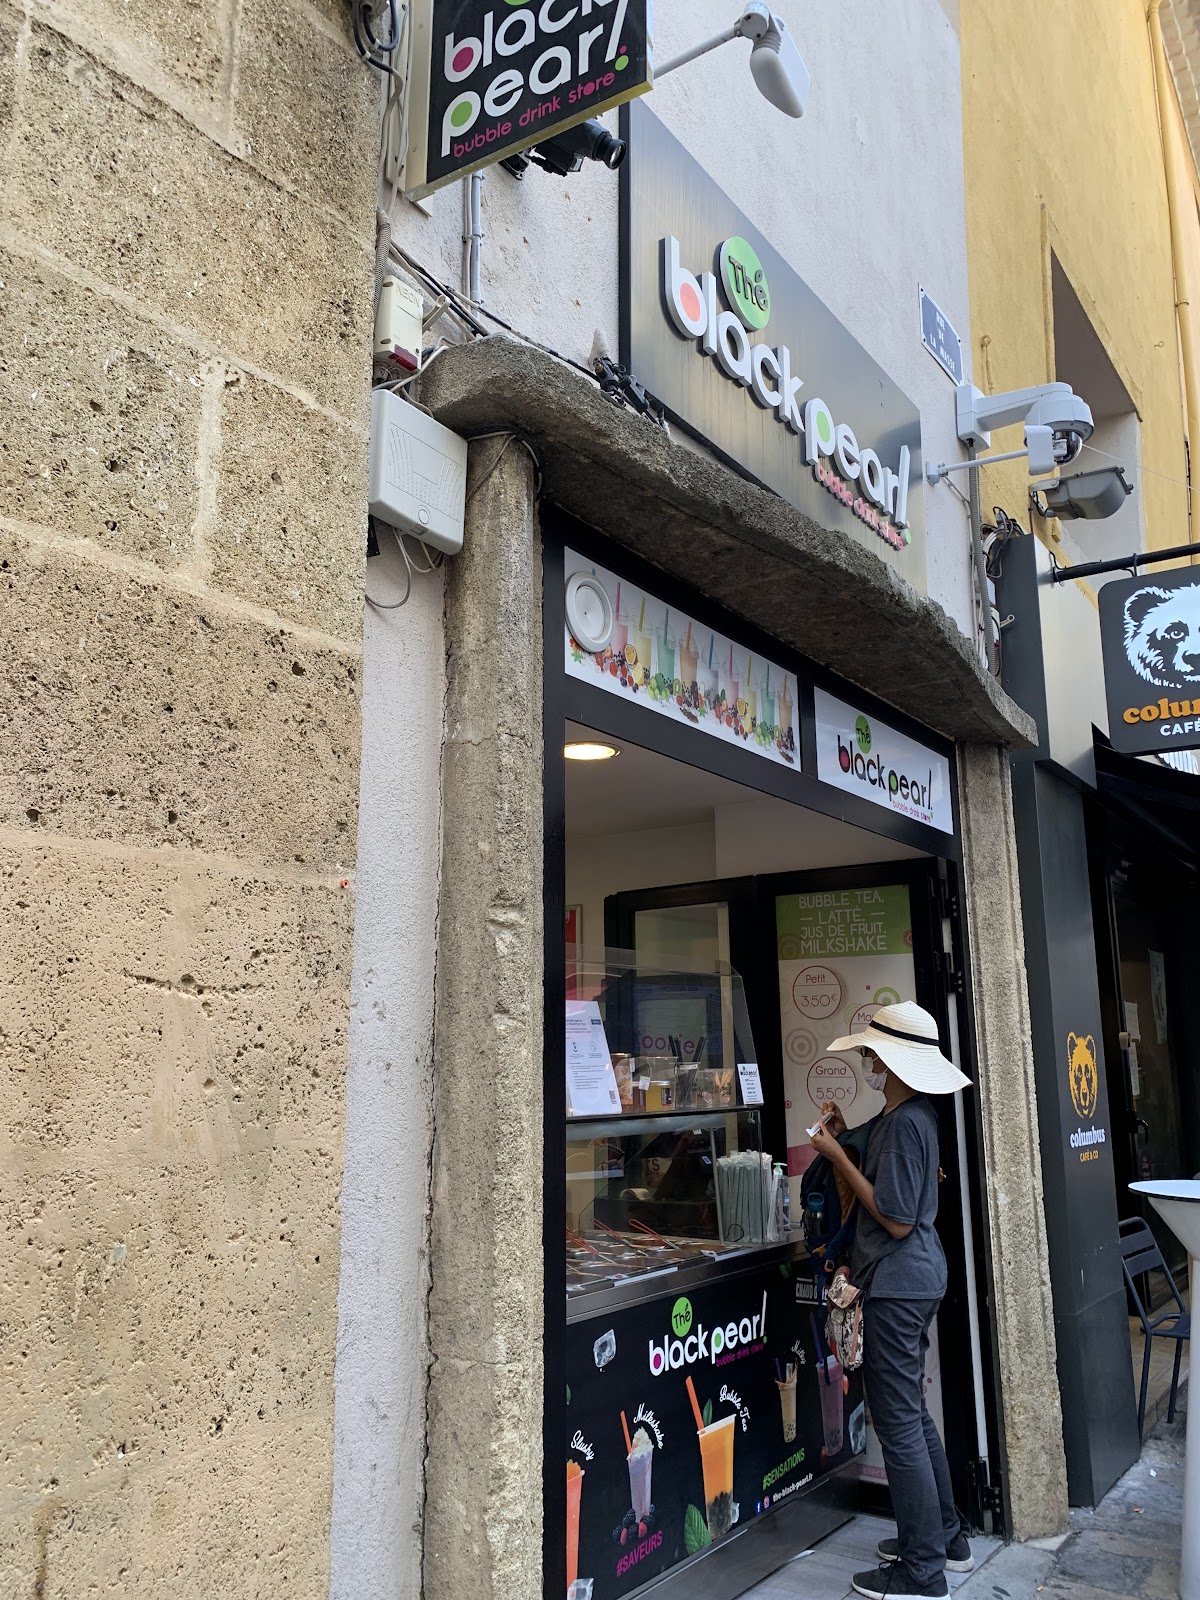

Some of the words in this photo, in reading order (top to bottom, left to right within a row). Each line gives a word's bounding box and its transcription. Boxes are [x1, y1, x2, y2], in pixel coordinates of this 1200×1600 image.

[444, 0, 614, 83] blac
[453, 121, 512, 158] bubble
[518, 96, 562, 127] drink
[568, 72, 615, 105] store
[936, 310, 945, 331] RUE
[662, 235, 806, 434] black
[930, 333, 936, 348] LA
[938, 328, 944, 343] DE
[816, 459, 854, 508] bubble
[1123, 697, 1200, 724] colu
[837, 734, 886, 790] black
[892, 800, 909, 814] bubble
[909, 806, 920, 818] drink
[799, 893, 849, 909] BUBBLE
[801, 926, 823, 939] JUS
[828, 925, 845, 937] DE
[801, 935, 887, 954] MILKSHAKE
[805, 973, 825, 985] Petit
[815, 1065, 847, 1076] Grand
[1070, 1125, 1105, 1148] columbus
[1093, 1150, 1098, 1160] CO
[649, 1324, 709, 1376] black
[716, 1353, 735, 1367] bubble
[736, 1346, 750, 1359] drink
[751, 1342, 764, 1354] store
[633, 1402, 664, 1449] Milkshake
[740, 1406, 750, 1432] Tea
[571, 1429, 594, 1461] Slushy
[762, 1447, 805, 1491] #SENSATIONS
[616, 1529, 663, 1578] #SAVEURS
